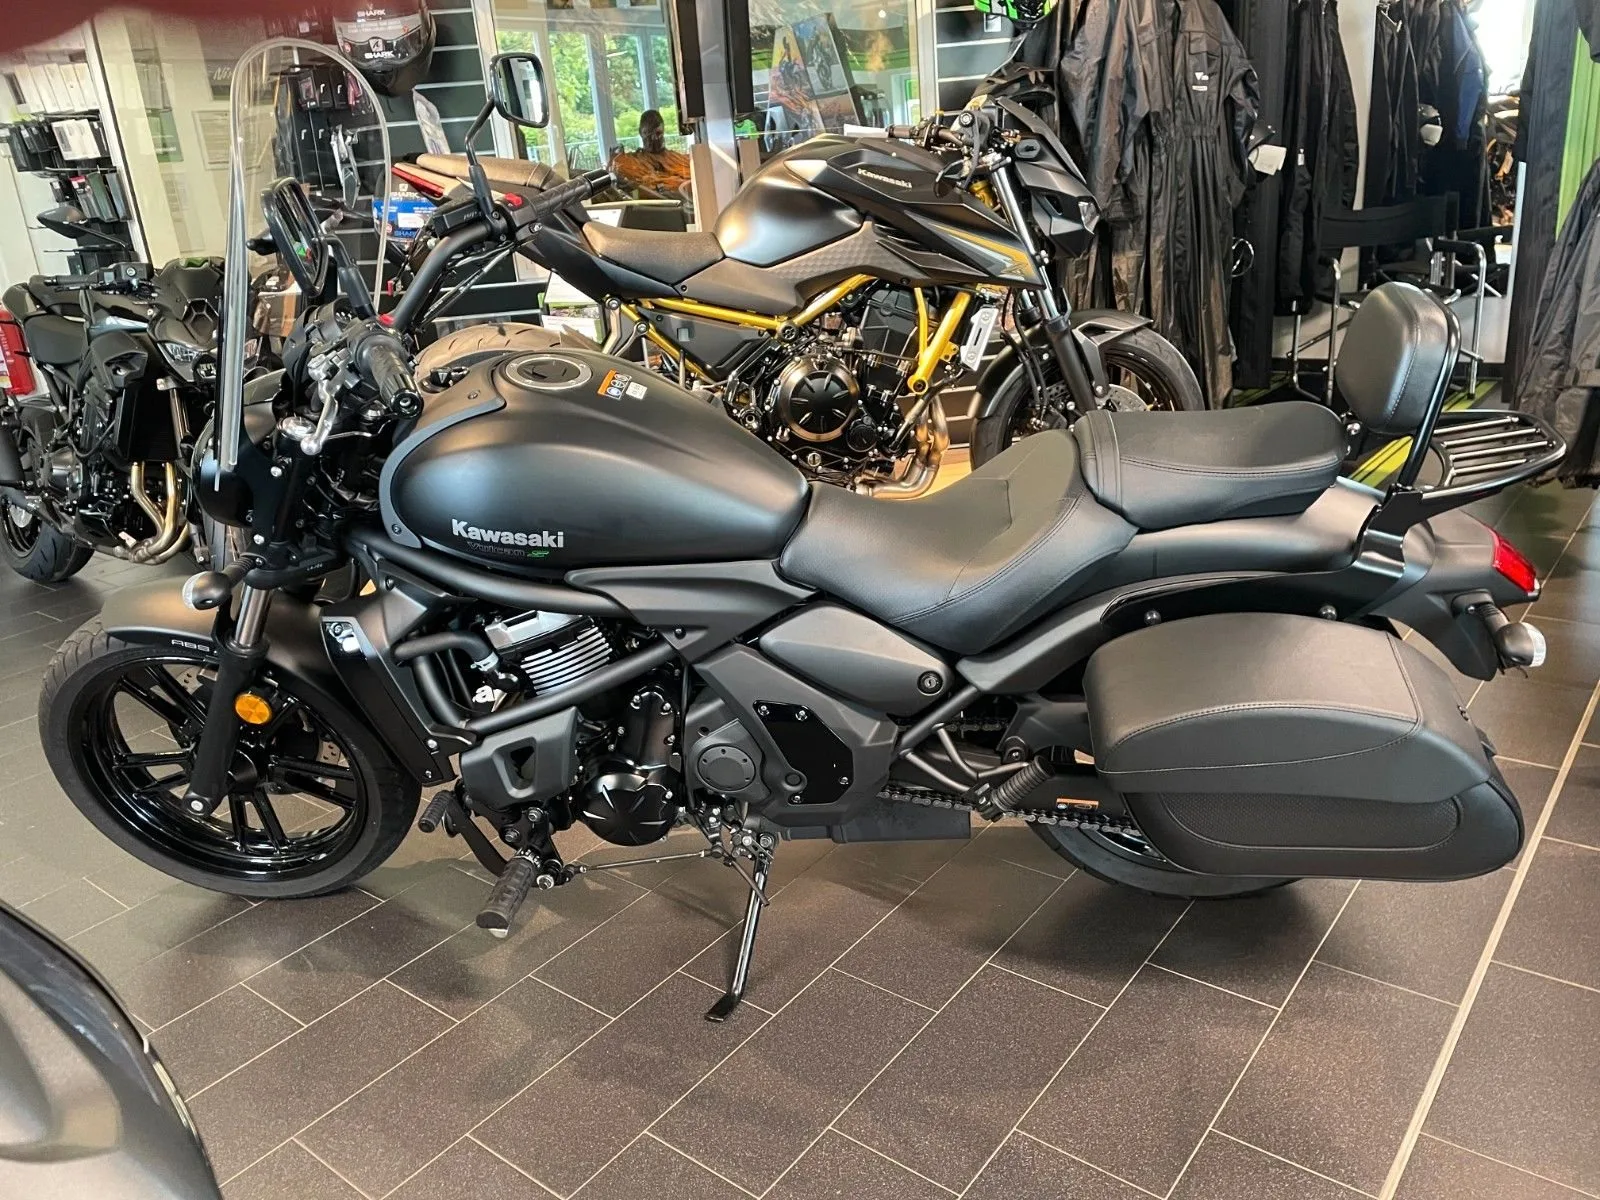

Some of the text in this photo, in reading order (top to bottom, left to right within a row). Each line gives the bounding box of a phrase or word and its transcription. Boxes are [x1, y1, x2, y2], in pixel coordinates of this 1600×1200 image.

[364, 50, 395, 59] SHARK
[857, 167, 912, 189] Kawasaki
[451, 518, 564, 548] Kawasaki
[171, 639, 210, 652] ABS
